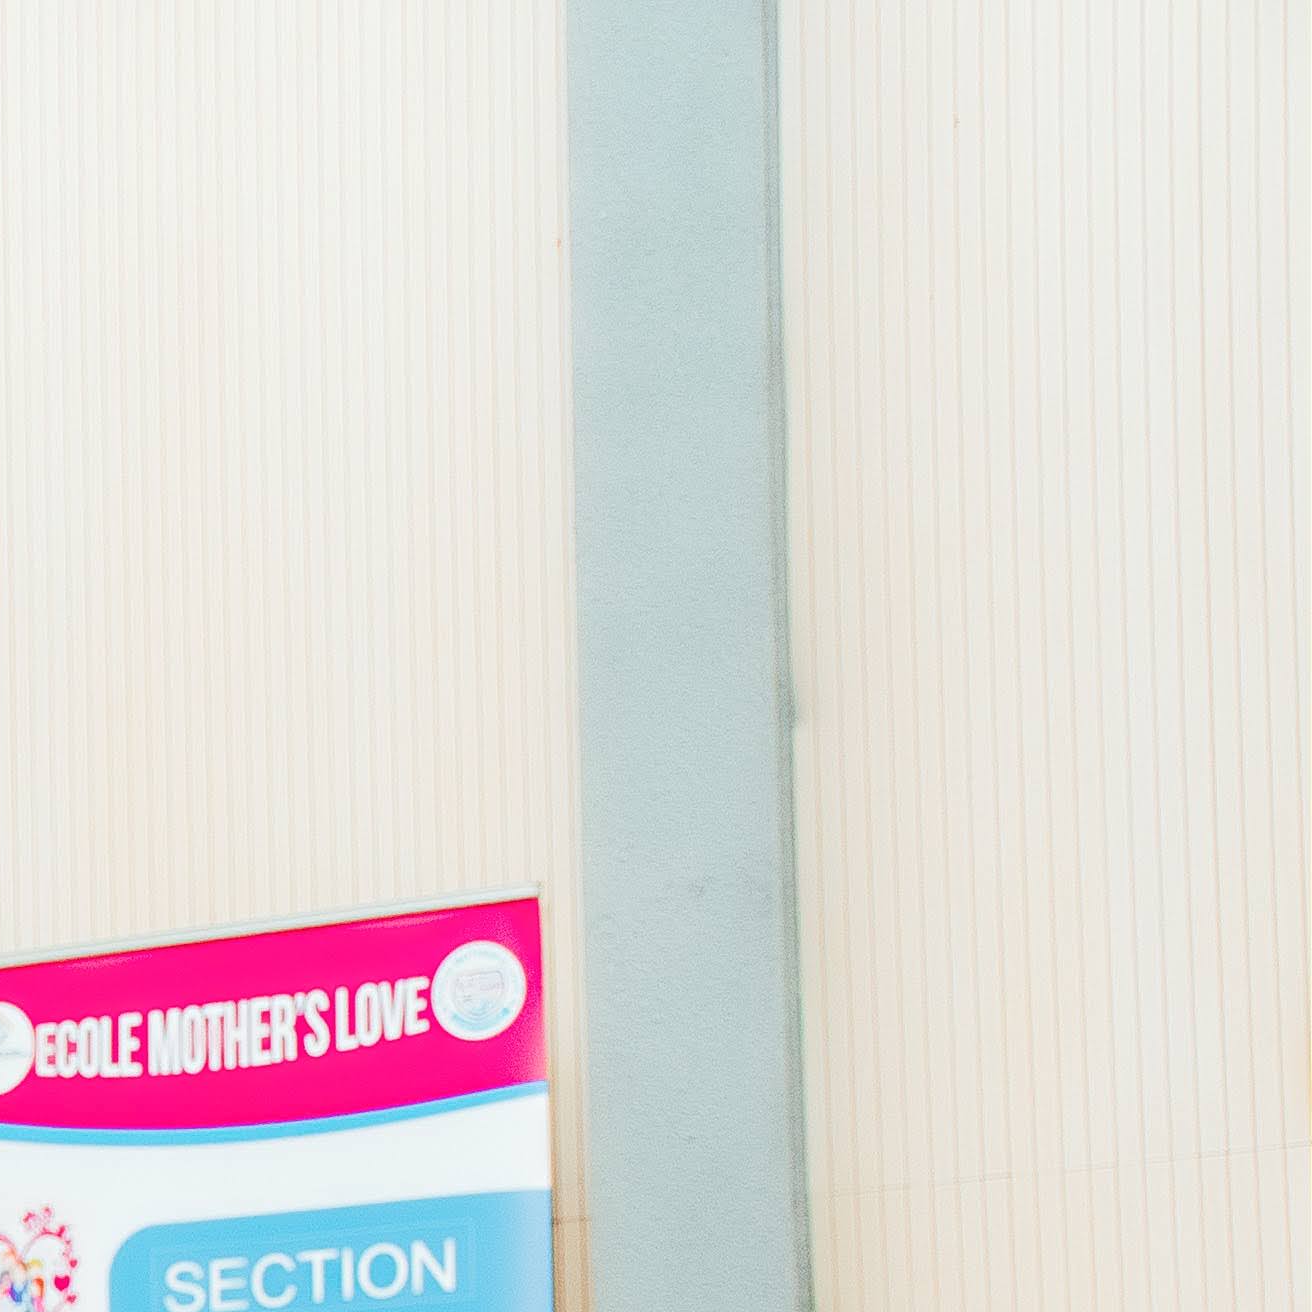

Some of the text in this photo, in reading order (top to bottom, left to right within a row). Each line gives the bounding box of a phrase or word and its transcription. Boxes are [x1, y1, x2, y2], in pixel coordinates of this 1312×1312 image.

[34, 1012, 143, 1080] ECOLE
[147, 989, 332, 1077] MOTHER'S
[334, 977, 431, 1053] LOVE
